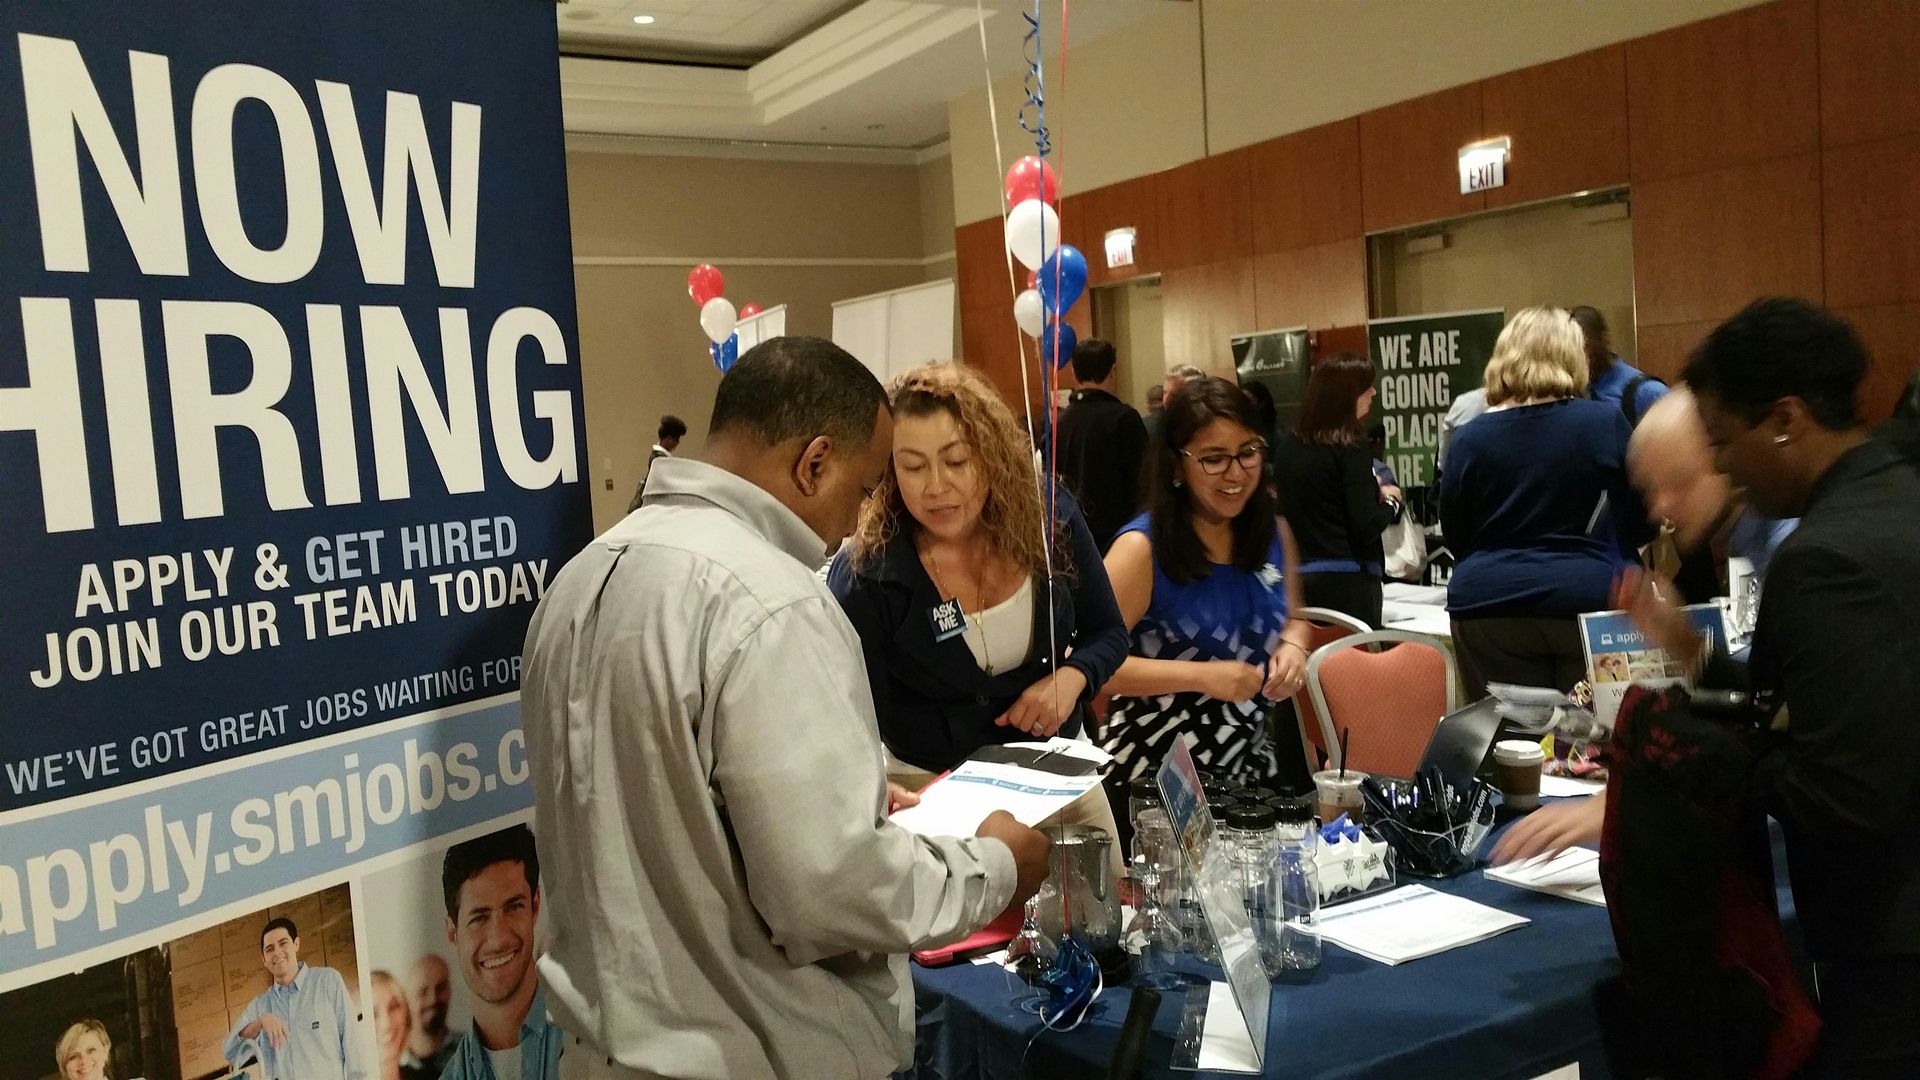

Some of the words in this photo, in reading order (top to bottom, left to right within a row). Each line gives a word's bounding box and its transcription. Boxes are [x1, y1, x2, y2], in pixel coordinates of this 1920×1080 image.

[17, 32, 481, 288] NOW
[1470, 162, 1496, 189] EXIT
[1379, 334, 1413, 370] WE
[1418, 330, 1461, 367] ARE
[1381, 372, 1450, 410] GOING
[0, 296, 578, 533] HIRING
[1386, 453, 1426, 488] ARE
[75, 547, 234, 618] APPLY
[254, 542, 290, 591] &
[305, 529, 385, 584] GET
[400, 515, 518, 571] HIRED
[30, 617, 162, 688] JOIN
[180, 600, 281, 662] OUR
[294, 578, 417, 641] TEAM
[429, 558, 549, 617] TODAY
[933, 601, 957, 621] ASK
[938, 614, 959, 632] ME
[5, 742, 120, 795] WE'VE
[130, 726, 189, 769] GOT
[200, 705, 289, 753] GREAT
[299, 688, 369, 730] JOBS
[374, 665, 475, 712] WAITING
[481, 655, 523, 688] FOR
